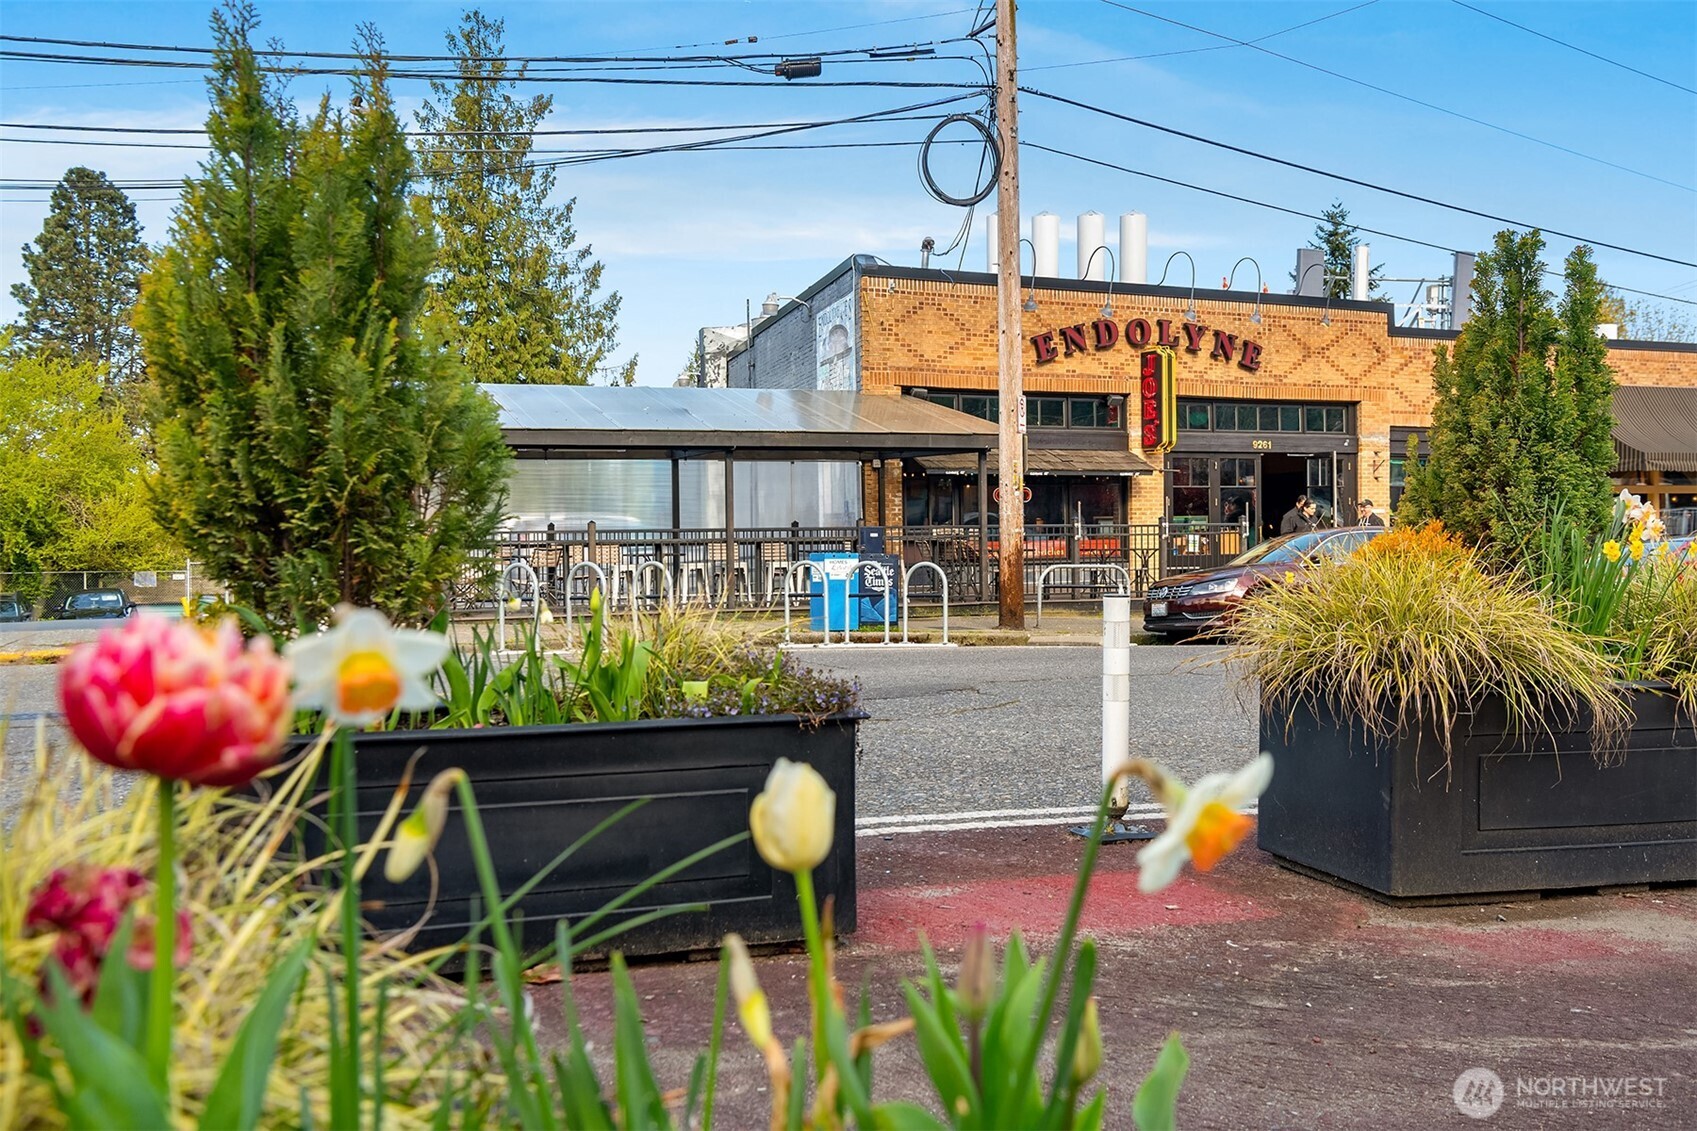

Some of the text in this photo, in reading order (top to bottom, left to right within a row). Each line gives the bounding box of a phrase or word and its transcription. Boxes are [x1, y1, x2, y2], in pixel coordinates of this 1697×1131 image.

[1030, 318, 1263, 371] ENDOLYNE
[1142, 354, 1160, 446] JOE'S
[1252, 440, 1272, 450] 9261
[863, 565, 895, 576] Seatle
[864, 574, 894, 587] Tims
